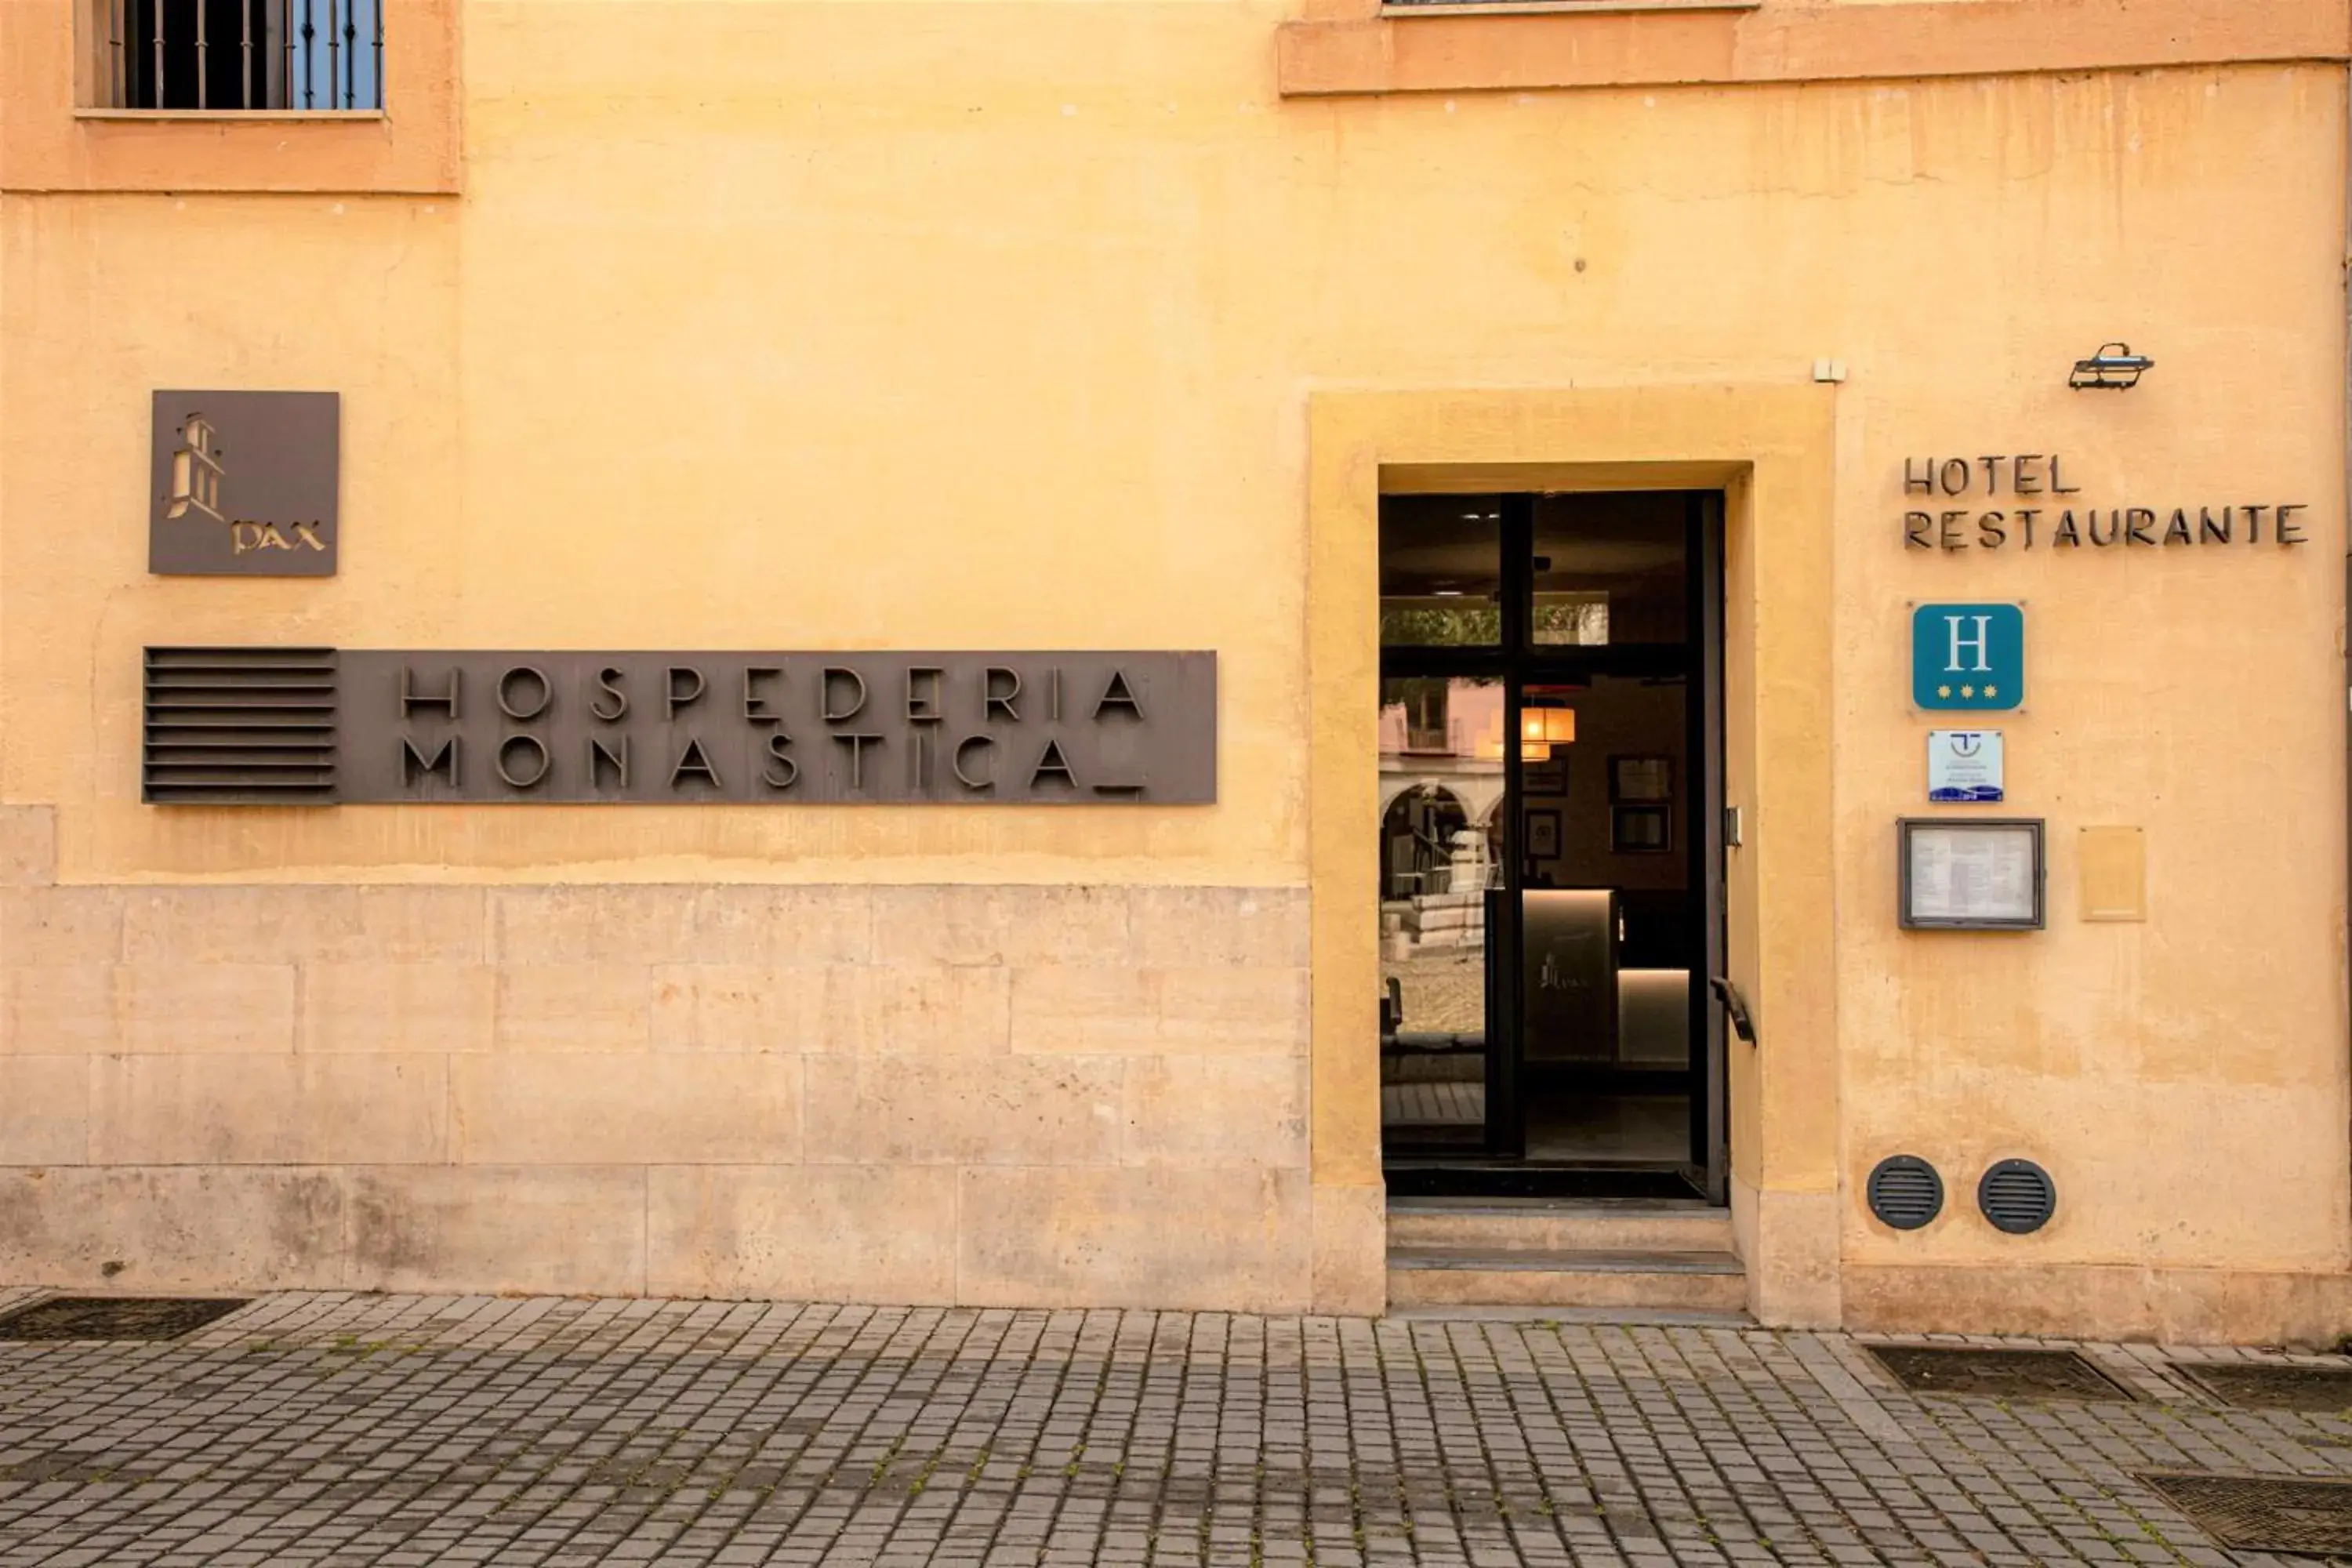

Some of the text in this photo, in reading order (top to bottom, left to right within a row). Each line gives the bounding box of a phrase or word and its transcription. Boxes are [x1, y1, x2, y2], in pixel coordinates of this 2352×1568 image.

[1904, 453, 2082, 497] HOTEL
[1904, 504, 2310, 551] RESTAURANTE
[1943, 615, 1994, 672] H
[400, 665, 1145, 721] HOSPEDERIA
